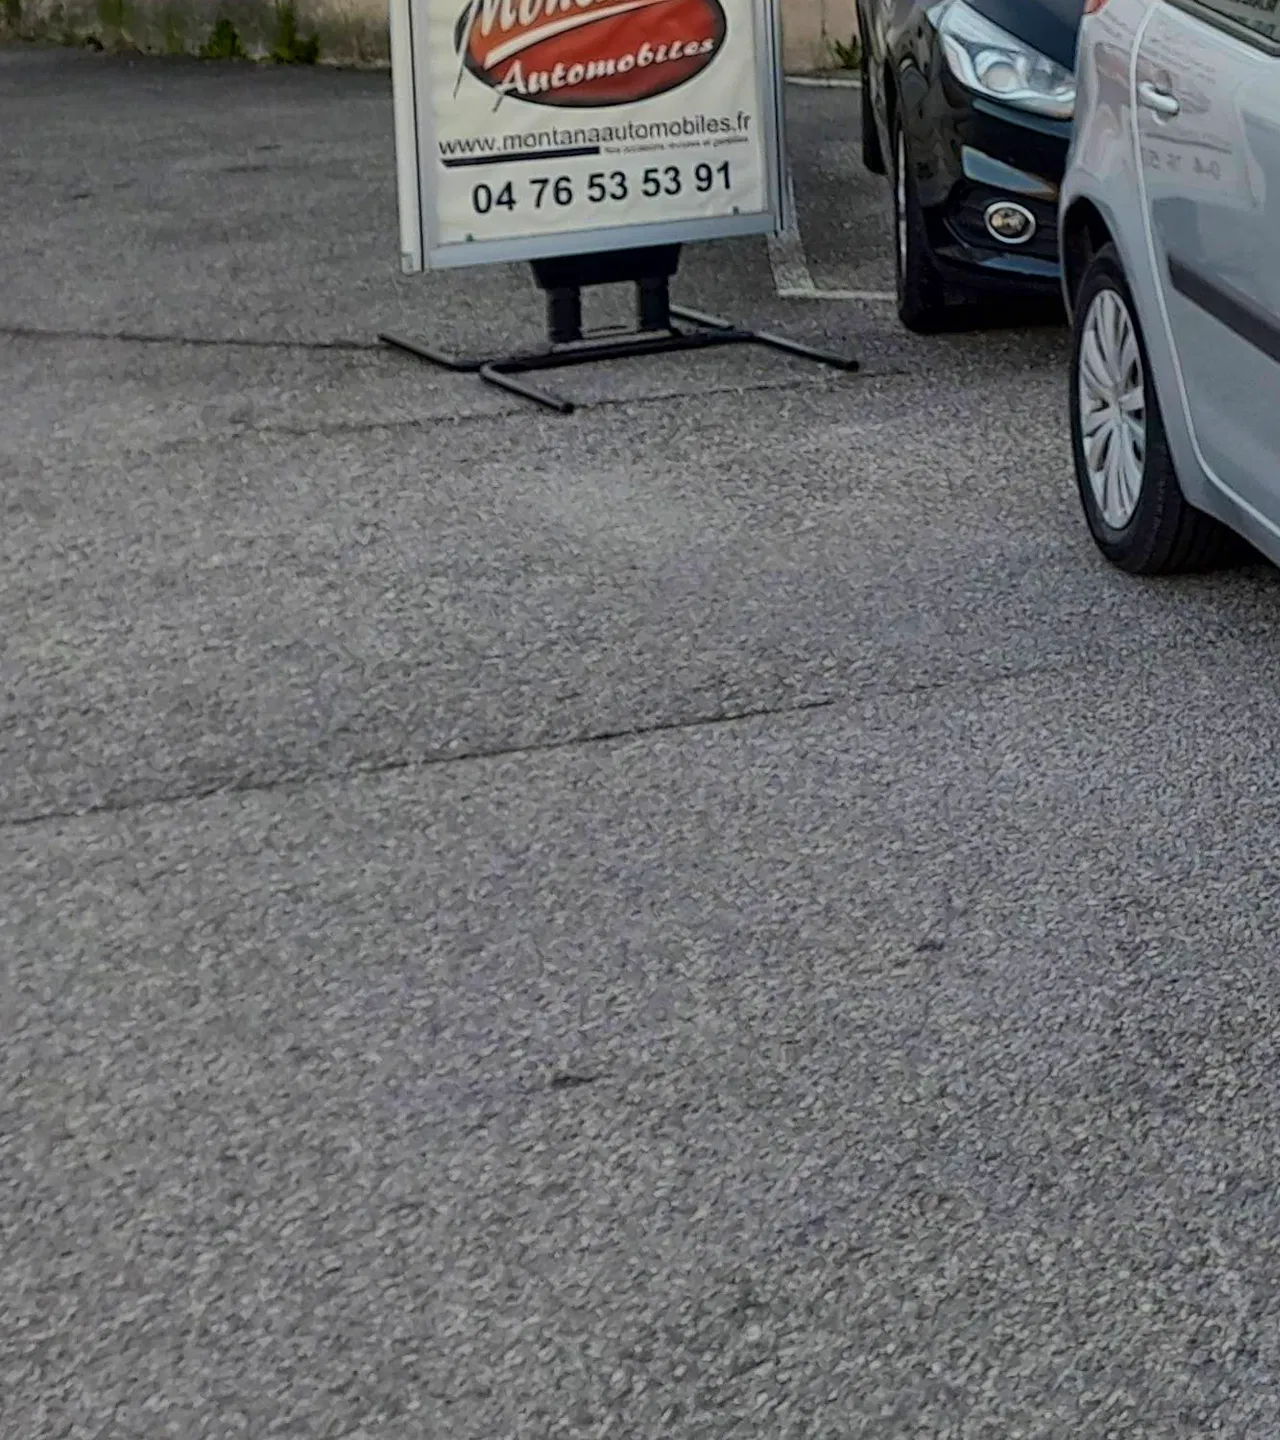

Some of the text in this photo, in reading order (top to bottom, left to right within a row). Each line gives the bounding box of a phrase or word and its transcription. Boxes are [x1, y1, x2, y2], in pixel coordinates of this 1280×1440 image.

[497, 38, 716, 103] Automobiles
[438, 112, 752, 157] www.montanaautomobiles.fr
[472, 161, 733, 214] 04 76 53 53 91
